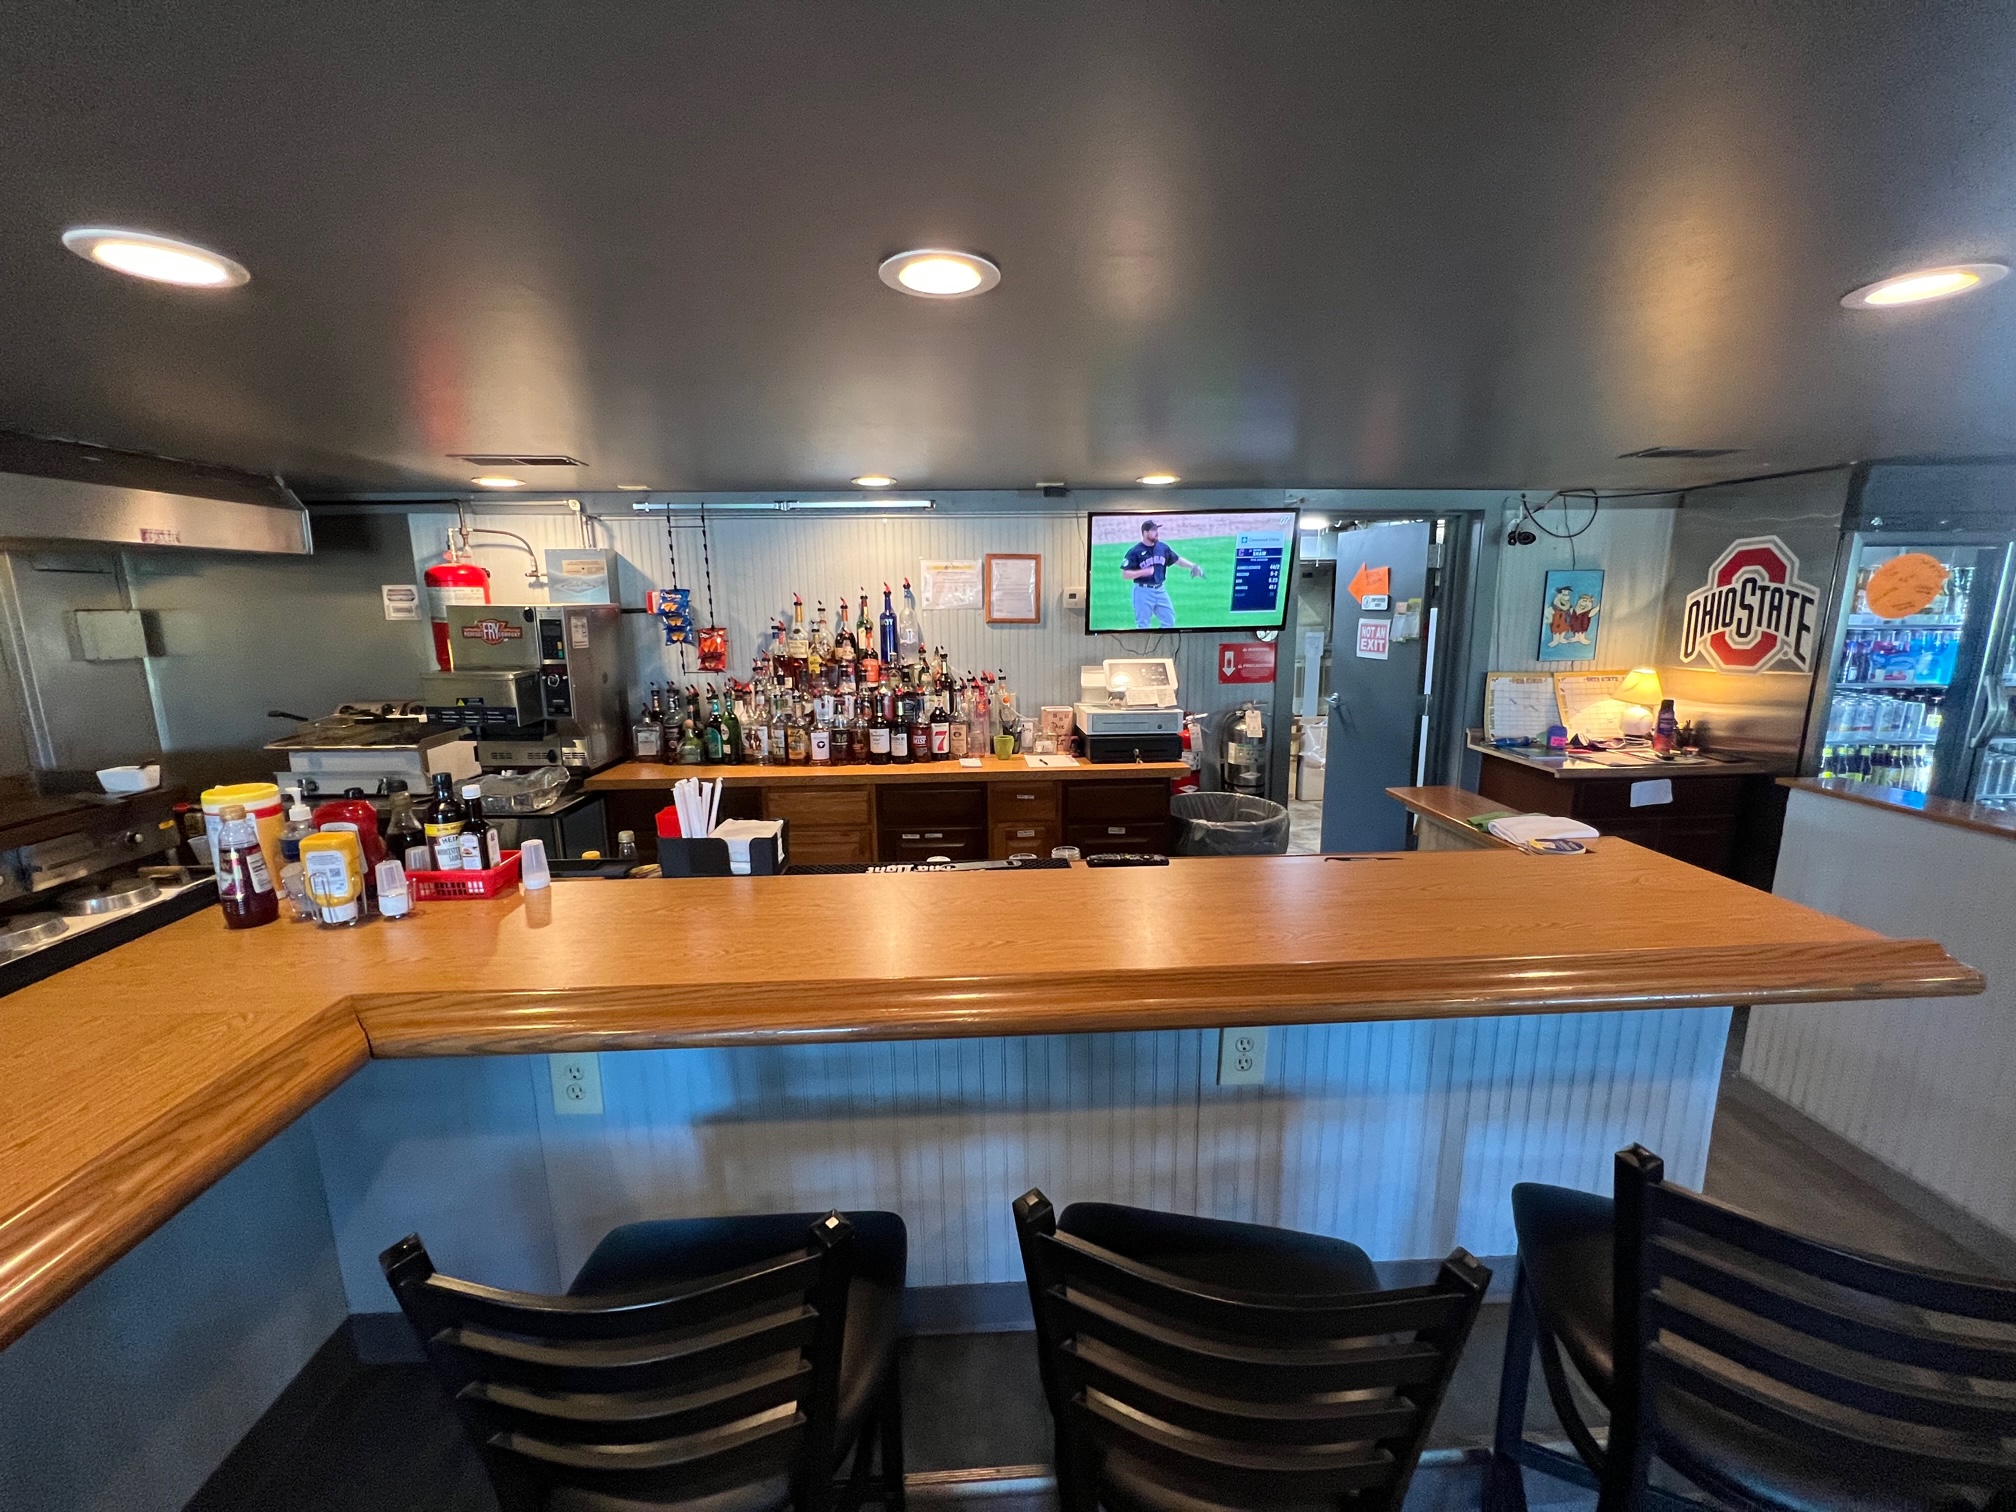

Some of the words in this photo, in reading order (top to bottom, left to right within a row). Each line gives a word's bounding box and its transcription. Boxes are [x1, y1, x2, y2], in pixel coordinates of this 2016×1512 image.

[1683, 586, 1738, 659] OHIO
[1735, 577, 1815, 665] STATE
[482, 622, 500, 640] FRY
[1361, 626, 1375, 638] NOT
[1375, 627, 1387, 638] AN
[1360, 639, 1385, 652] EXIT
[933, 731, 948, 752] 7
[441, 835, 459, 845] HEIN
